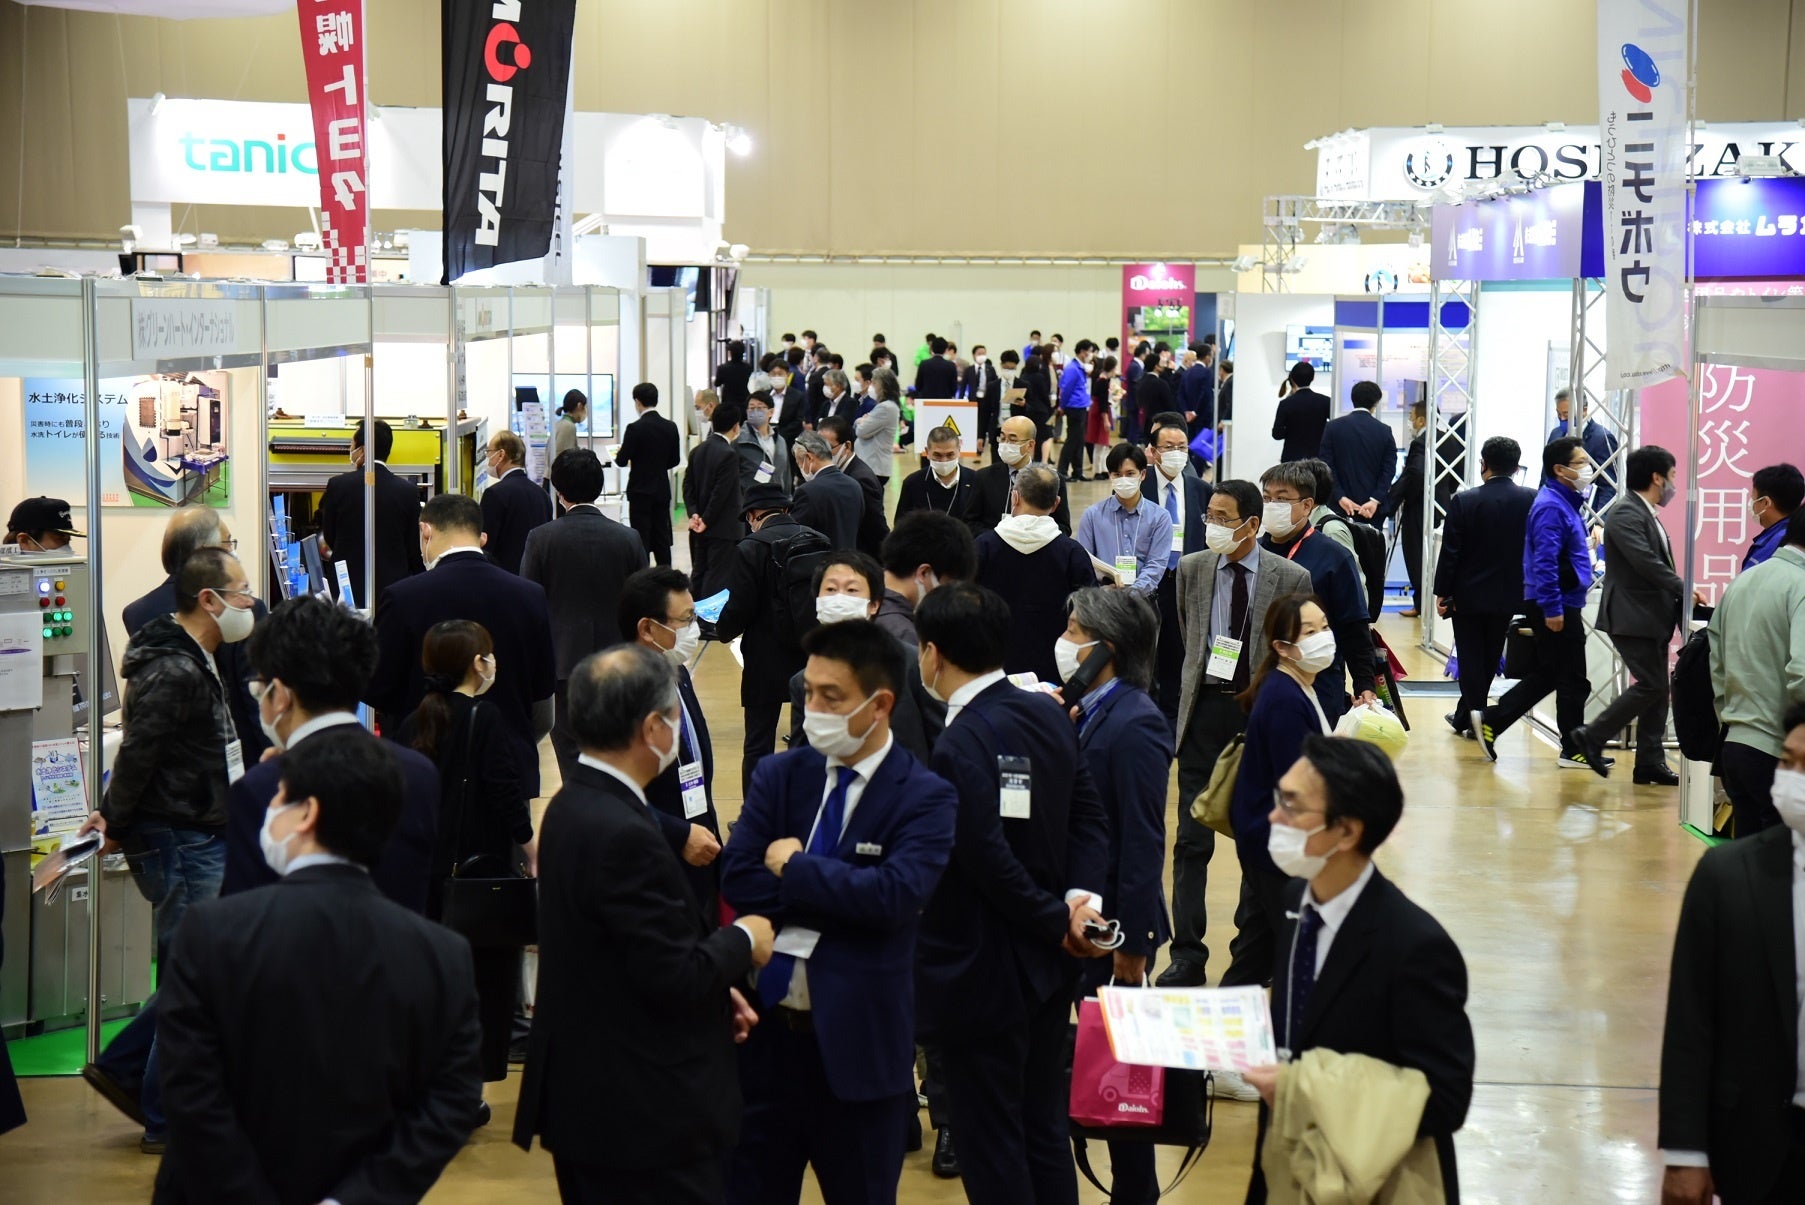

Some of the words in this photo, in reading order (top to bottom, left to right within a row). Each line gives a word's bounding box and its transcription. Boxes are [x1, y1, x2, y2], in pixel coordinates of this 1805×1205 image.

[1755, 215, 1805, 237] ムラ
[1694, 362, 1755, 607] 防災用品
